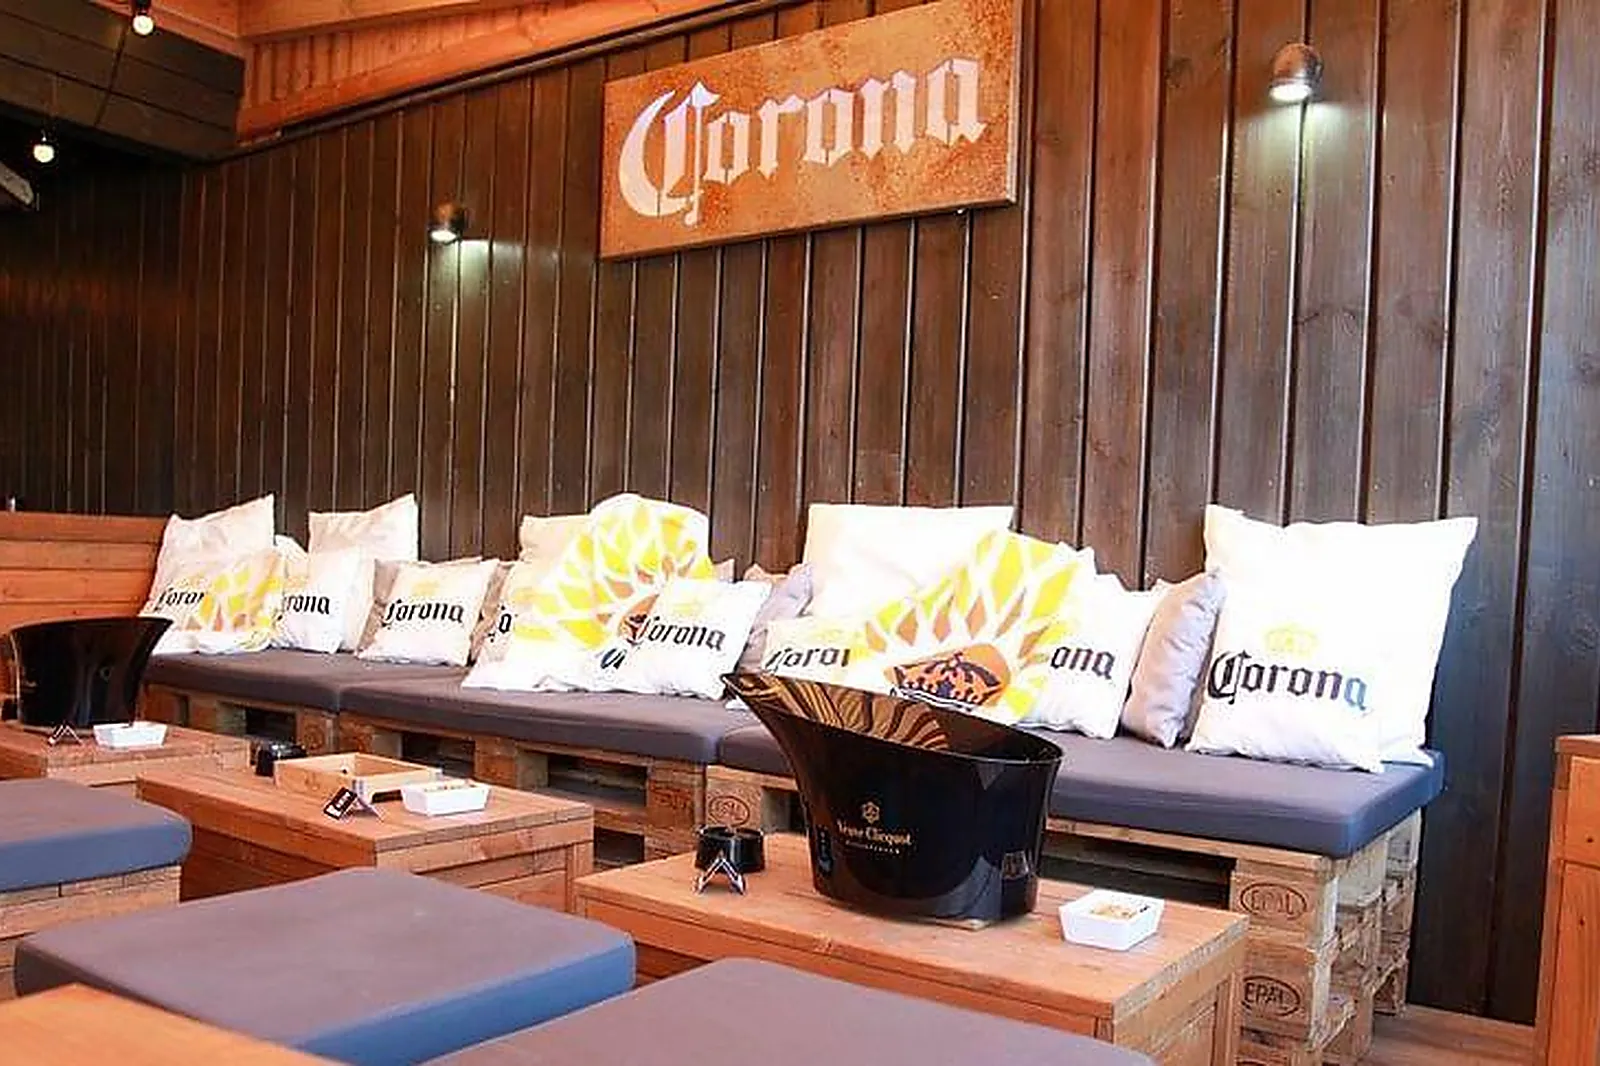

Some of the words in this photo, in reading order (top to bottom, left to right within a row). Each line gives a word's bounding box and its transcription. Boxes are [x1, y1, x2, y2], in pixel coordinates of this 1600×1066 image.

[618, 57, 988, 226] Corona
[381, 599, 464, 631] Corona
[1050, 646, 1116, 681] ona
[1207, 649, 1369, 712] Corona
